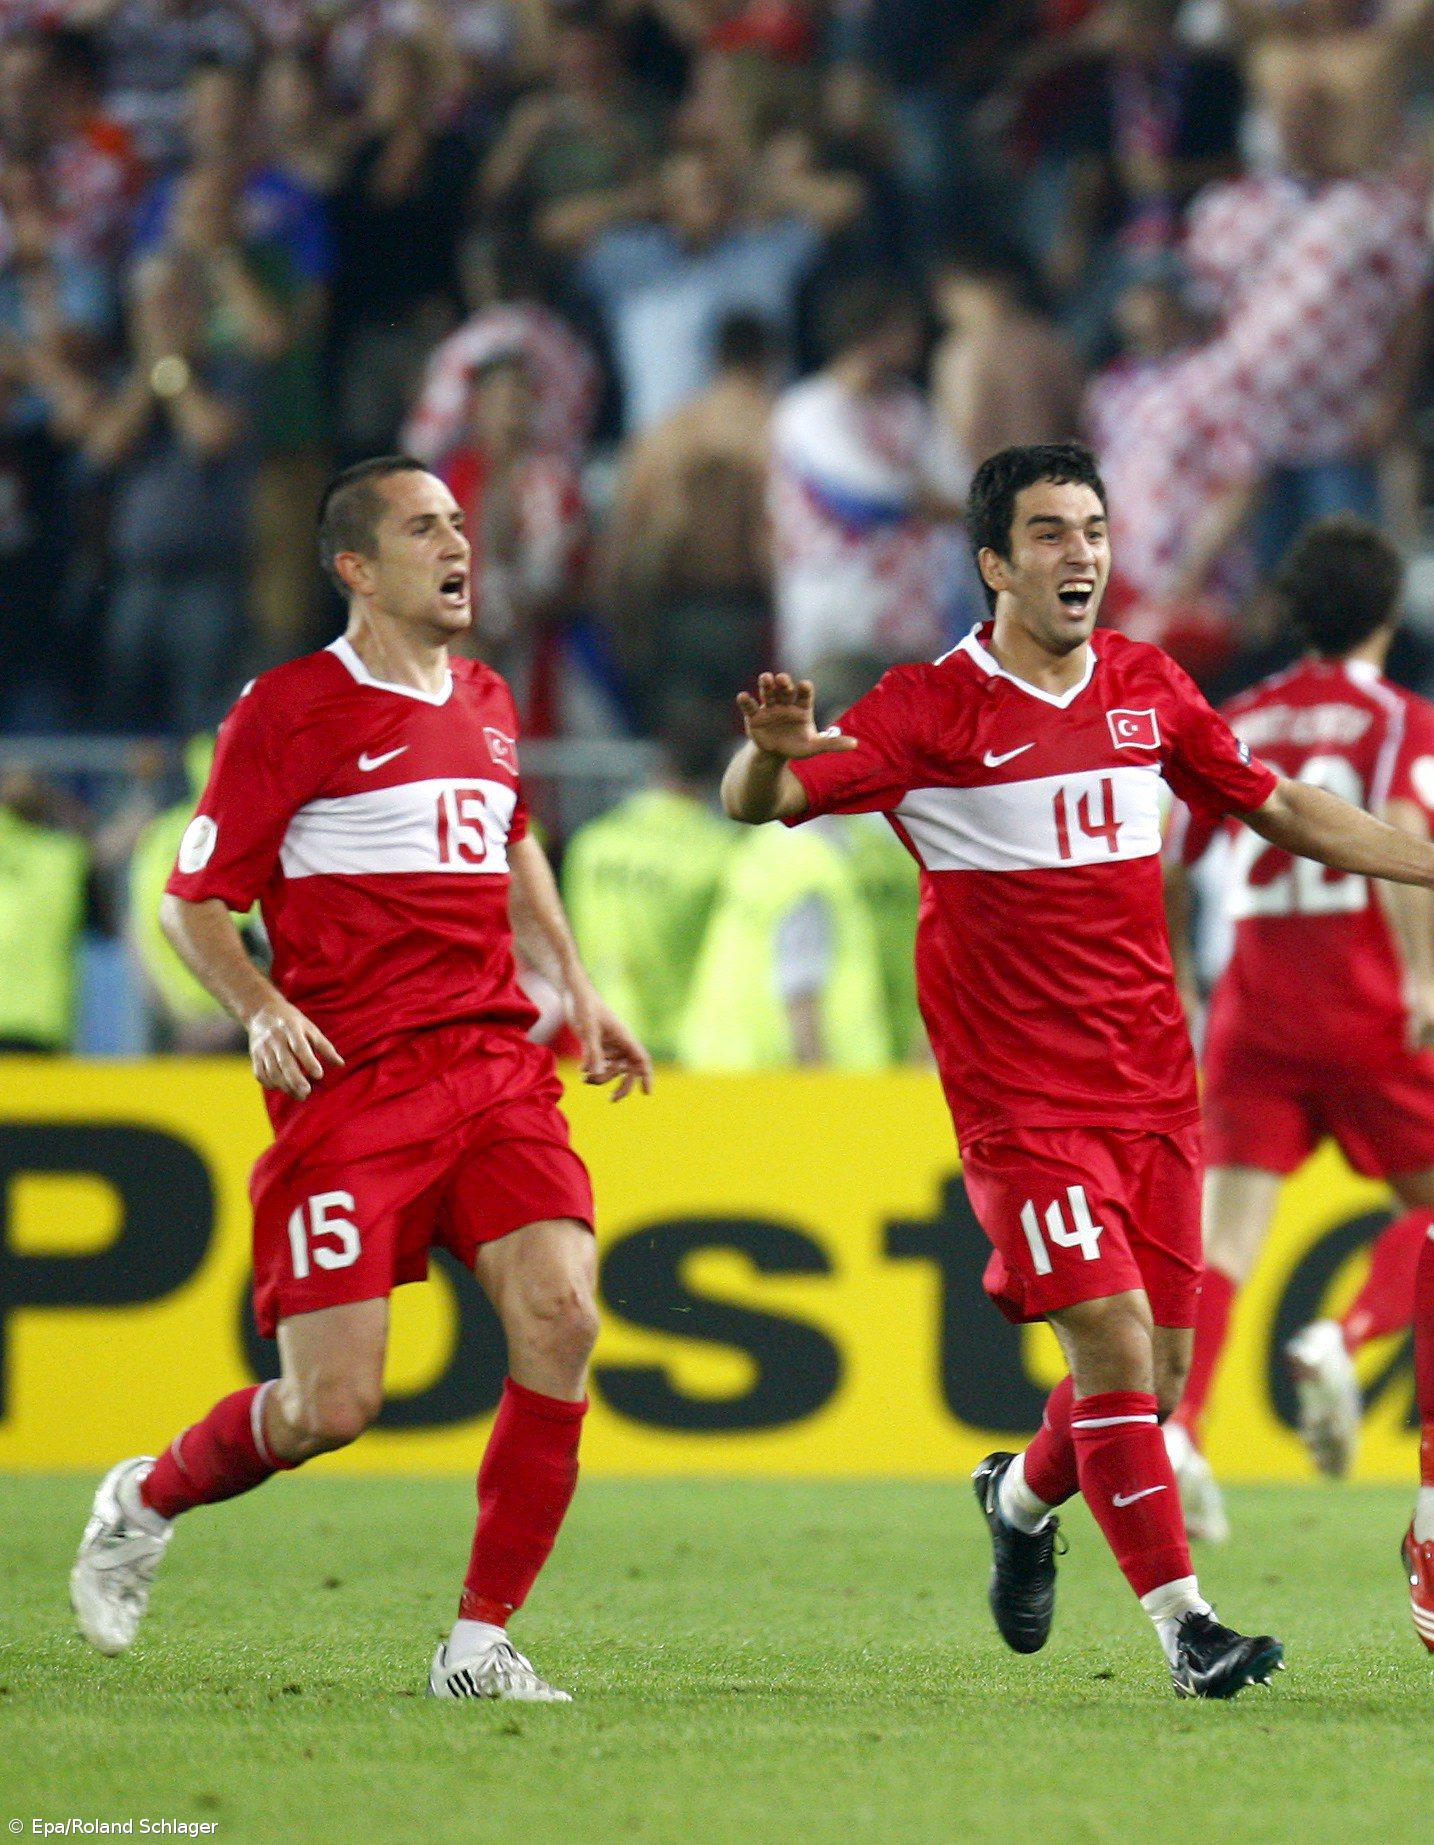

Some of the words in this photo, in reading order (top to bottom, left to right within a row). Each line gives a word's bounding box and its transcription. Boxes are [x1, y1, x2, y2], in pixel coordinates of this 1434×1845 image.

[436, 788, 487, 864] 15
[1053, 777, 1124, 860] 14
[287, 1190, 361, 1280] 15
[1020, 1185, 1104, 1276] 14
